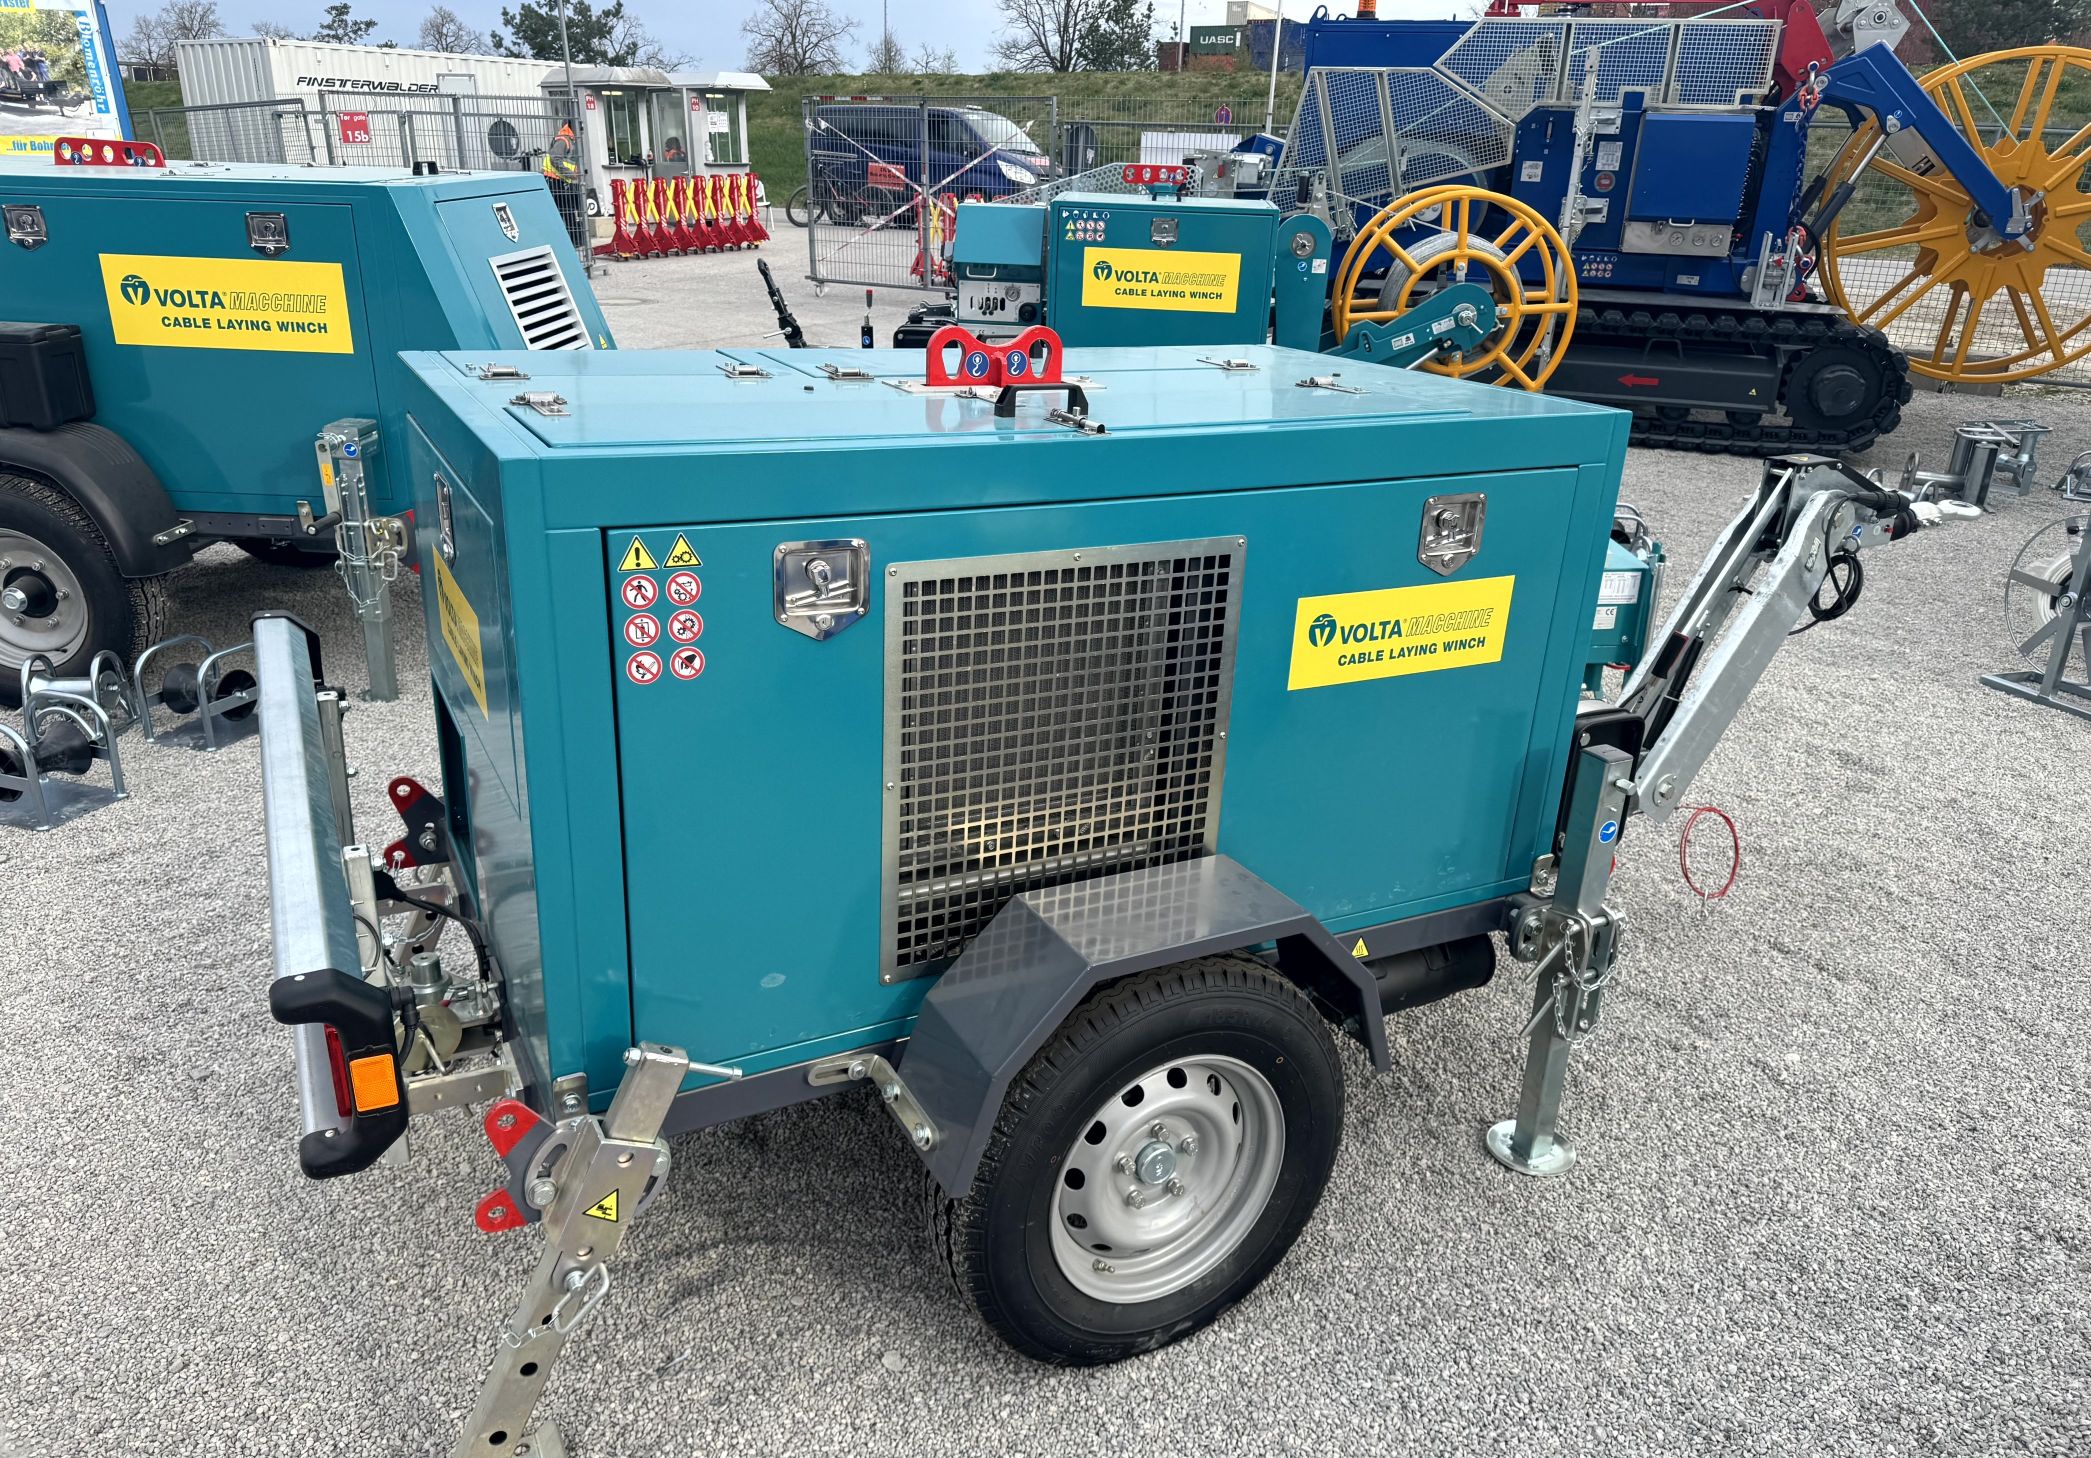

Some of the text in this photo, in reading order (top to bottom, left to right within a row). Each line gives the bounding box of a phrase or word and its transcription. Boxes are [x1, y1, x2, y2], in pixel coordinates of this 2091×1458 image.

[1200, 35, 1234, 44] UASC
[347, 130, 369, 142] 15b
[1161, 271, 1226, 287] MACCHINE
[229, 291, 327, 313] MACCHINE
[1115, 287, 1223, 300] CABLE LAYING WINCH
[161, 316, 328, 334] CABLE LAYING WINCH
[1405, 607, 1494, 637] MACCHINE
[1337, 636, 1486, 667] CABLE LAYING WINCH
